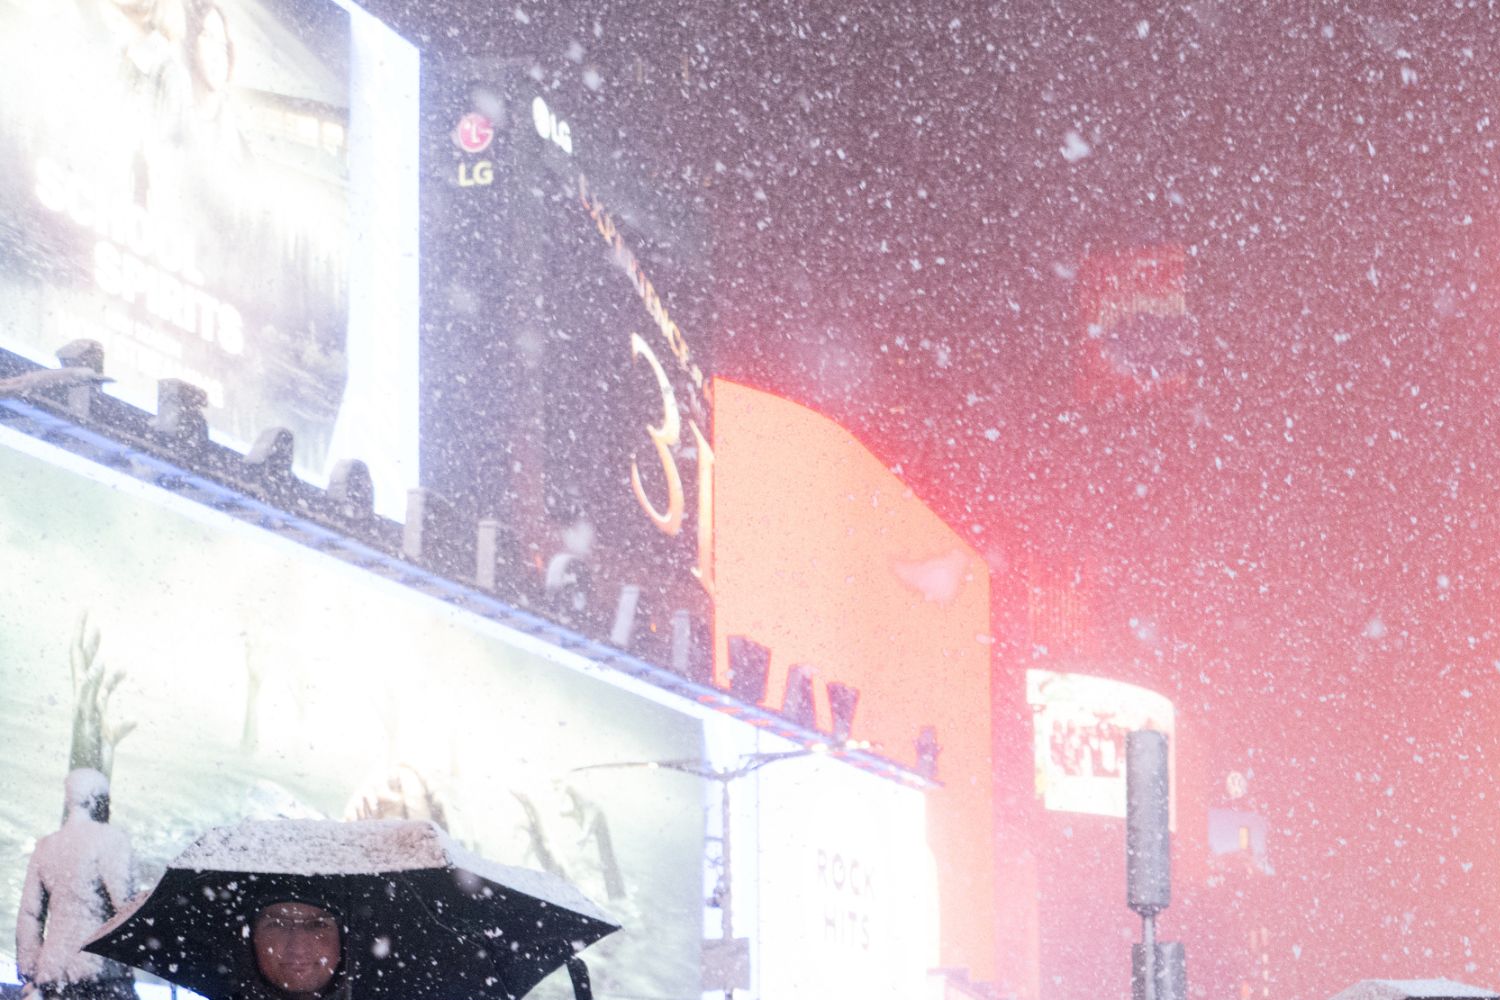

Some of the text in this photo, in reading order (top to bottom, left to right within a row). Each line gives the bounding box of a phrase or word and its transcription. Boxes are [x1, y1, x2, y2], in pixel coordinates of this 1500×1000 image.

[458, 161, 494, 187] LG
[816, 847, 876, 902] ROCK
[822, 902, 870, 952] HITS
